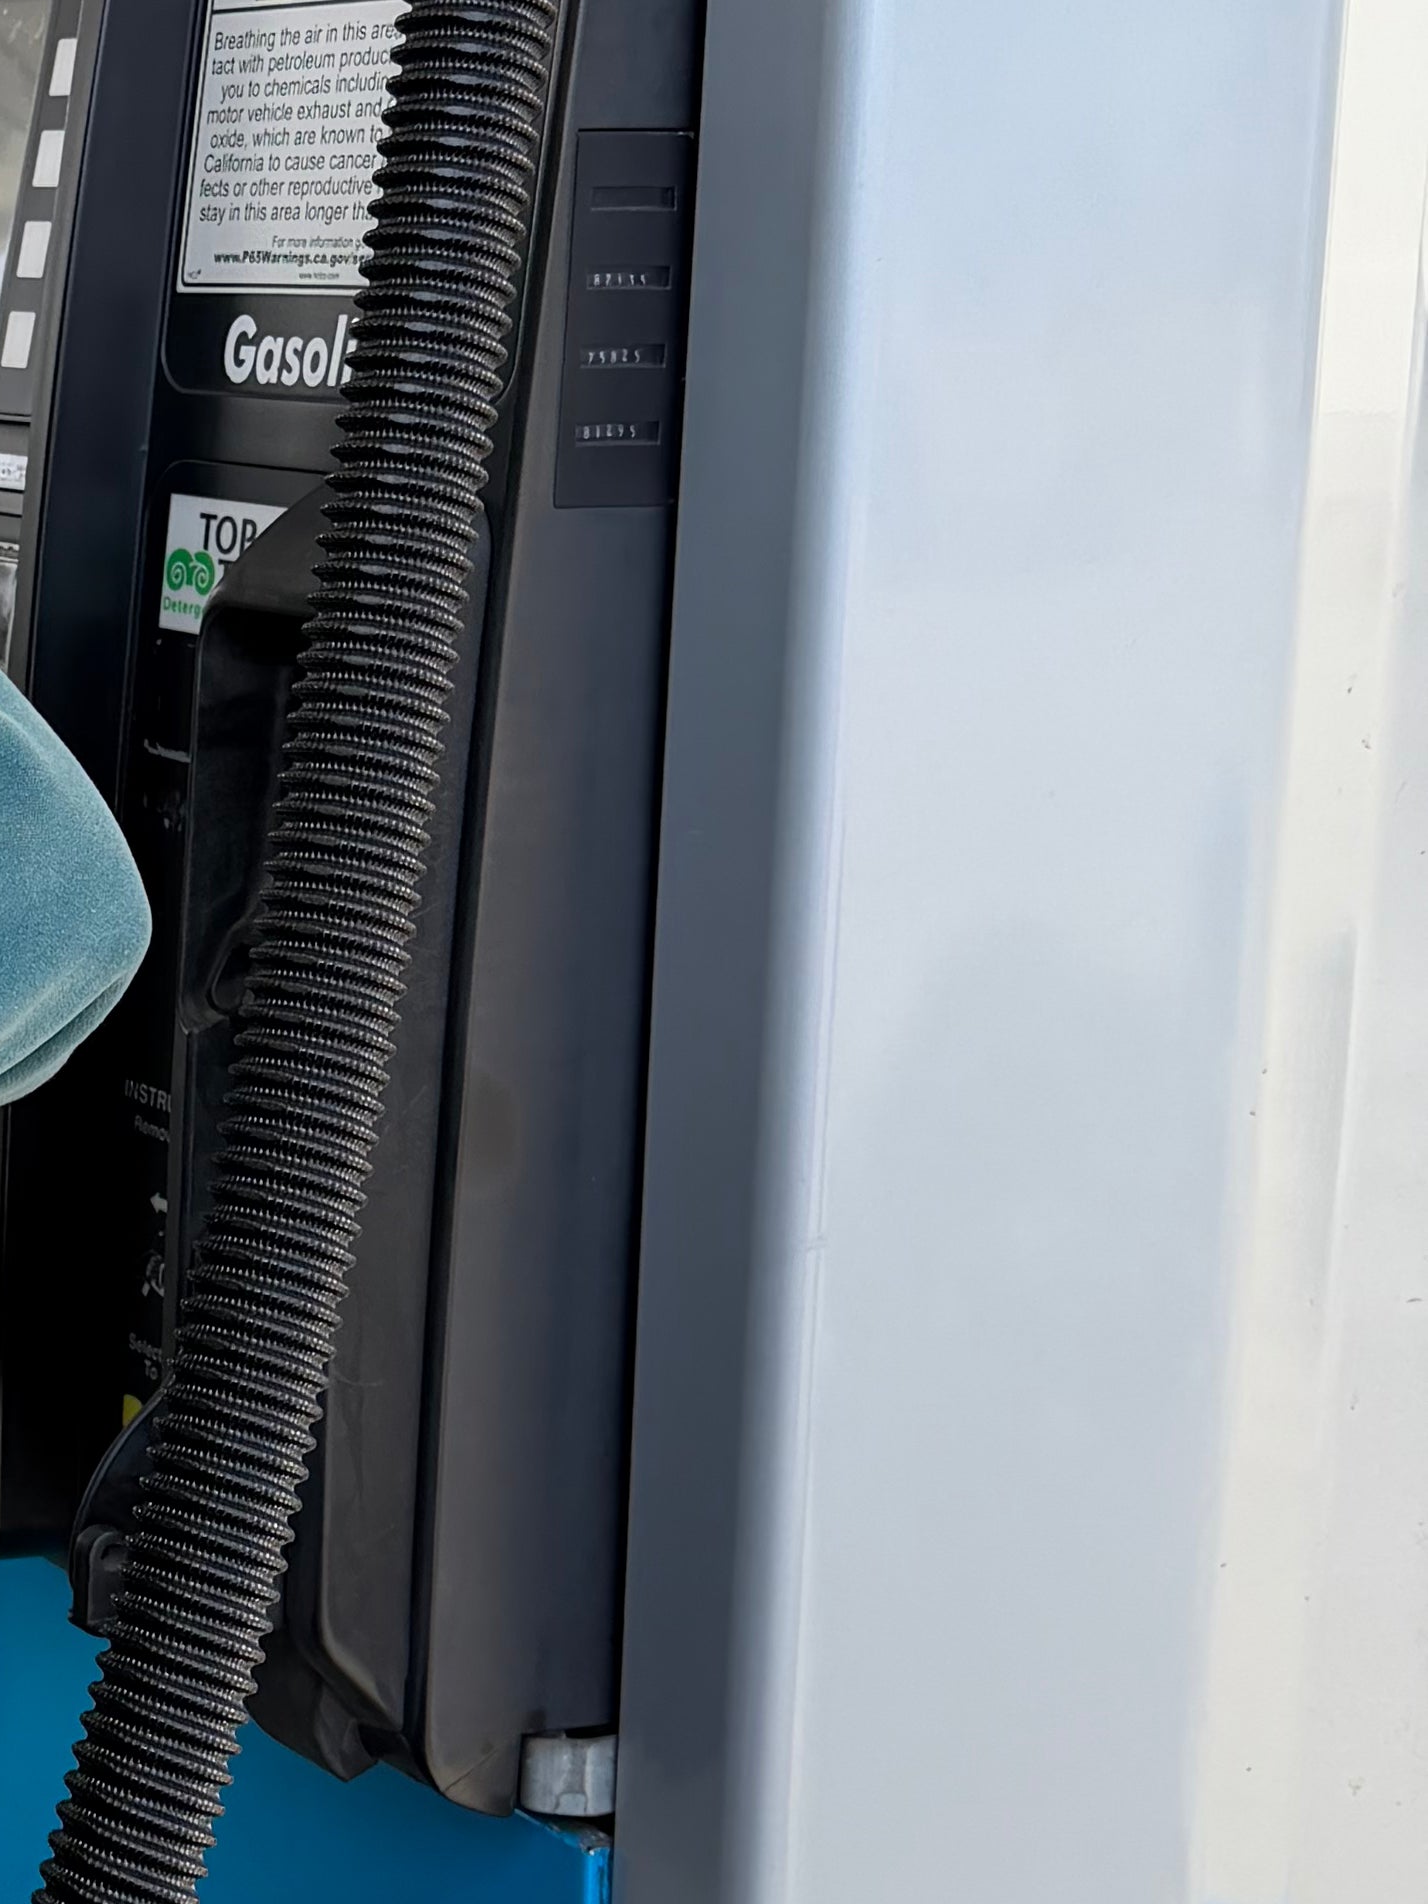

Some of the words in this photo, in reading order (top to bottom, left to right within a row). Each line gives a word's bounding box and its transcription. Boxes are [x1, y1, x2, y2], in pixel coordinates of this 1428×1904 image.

[215, 29, 275, 52] Breathing
[280, 28, 300, 46] the
[305, 27, 323, 45] air
[326, 24, 337, 43] in
[343, 21, 366, 42] this
[212, 58, 235, 75] tact
[239, 55, 264, 73] with
[268, 51, 335, 76] petroleum
[339, 47, 392, 71] produc
[220, 84, 244, 104] you
[248, 81, 260, 98] to
[264, 74, 331, 97] chemicals
[335, 72, 388, 93] includin
[207, 106, 244, 125] motor
[247, 103, 293, 122] vehicle
[297, 100, 351, 121] exhaust
[355, 98, 382, 118] and
[210, 130, 248, 150] oxide,
[252, 127, 289, 147] which
[294, 129, 316, 146] are
[321, 126, 365, 145] known
[204, 153, 264, 173] California
[269, 154, 280, 171] to
[285, 155, 325, 171] cause
[329, 153, 377, 170] cancer
[199, 178, 229, 198] fects
[233, 182, 247, 197] or
[250, 176, 284, 197] other
[287, 176, 372, 201] reproductive
[199, 203, 226, 226] stay
[229, 202, 240, 221] in
[244, 201, 266, 221] this
[271, 206, 300, 221] area
[305, 202, 349, 226] longer
[272, 236, 284, 247] For
[287, 237, 307, 247] more
[309, 236, 354, 247] information
